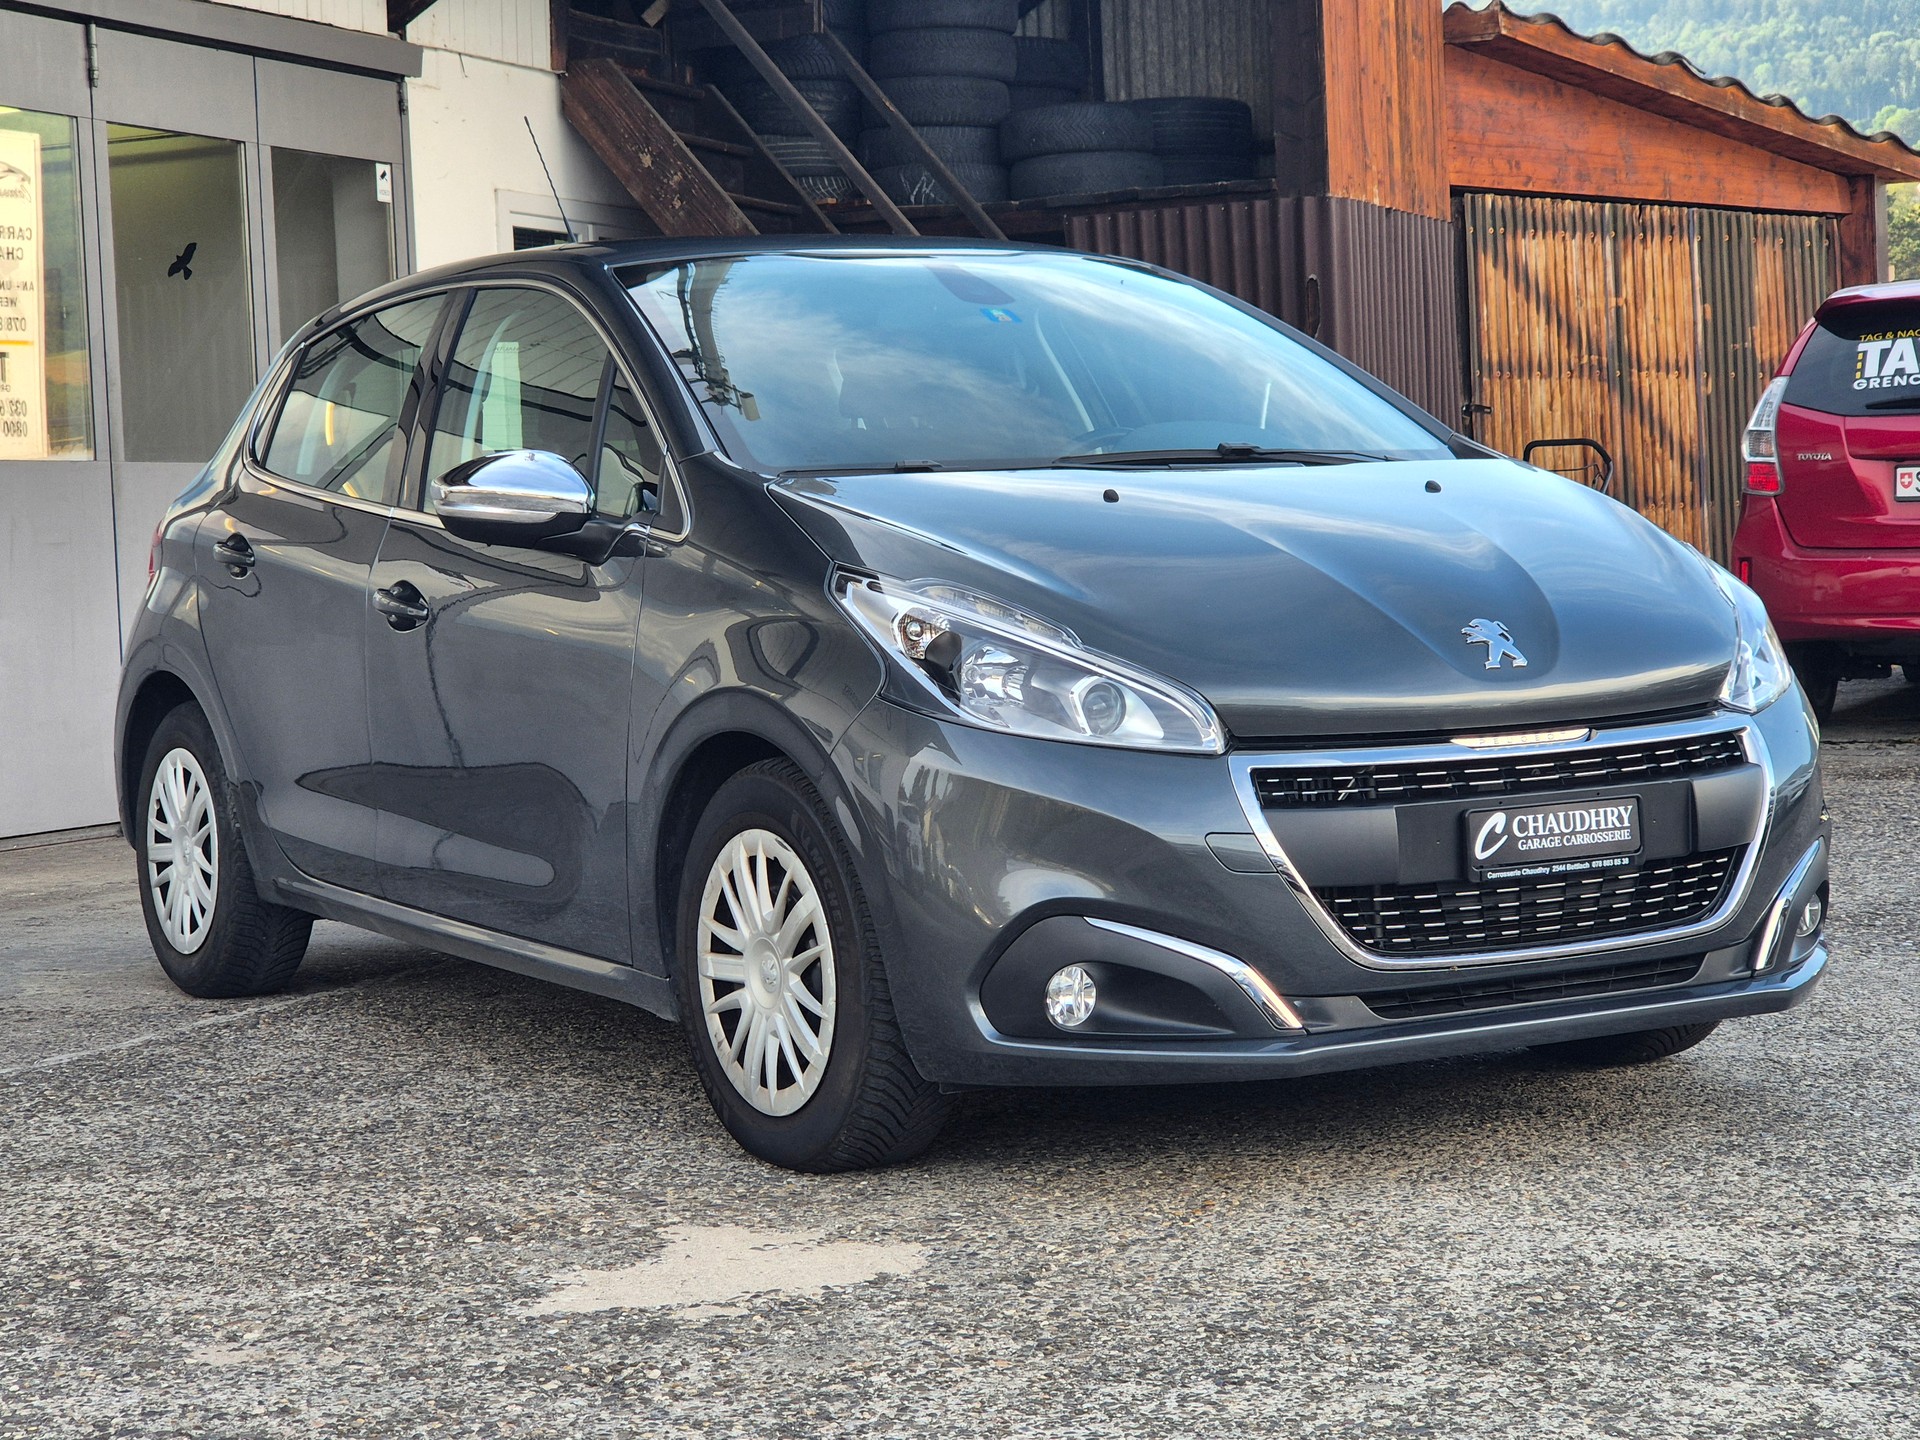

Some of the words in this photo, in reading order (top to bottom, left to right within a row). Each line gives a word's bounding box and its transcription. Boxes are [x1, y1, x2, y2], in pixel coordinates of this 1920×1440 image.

[1859, 332, 1883, 342] TAG
[1885, 331, 1895, 340] &
[1853, 373, 1920, 390] GRENC
[1797, 452, 1832, 461] TOYOTA
[1512, 805, 1633, 838] CHAUDHRY
[1518, 834, 1562, 851] GARAGE
[1563, 828, 1632, 846] CARROSSERIE
[1487, 869, 1521, 879] Carrosserie
[1521, 866, 1550, 875] Chaudhry
